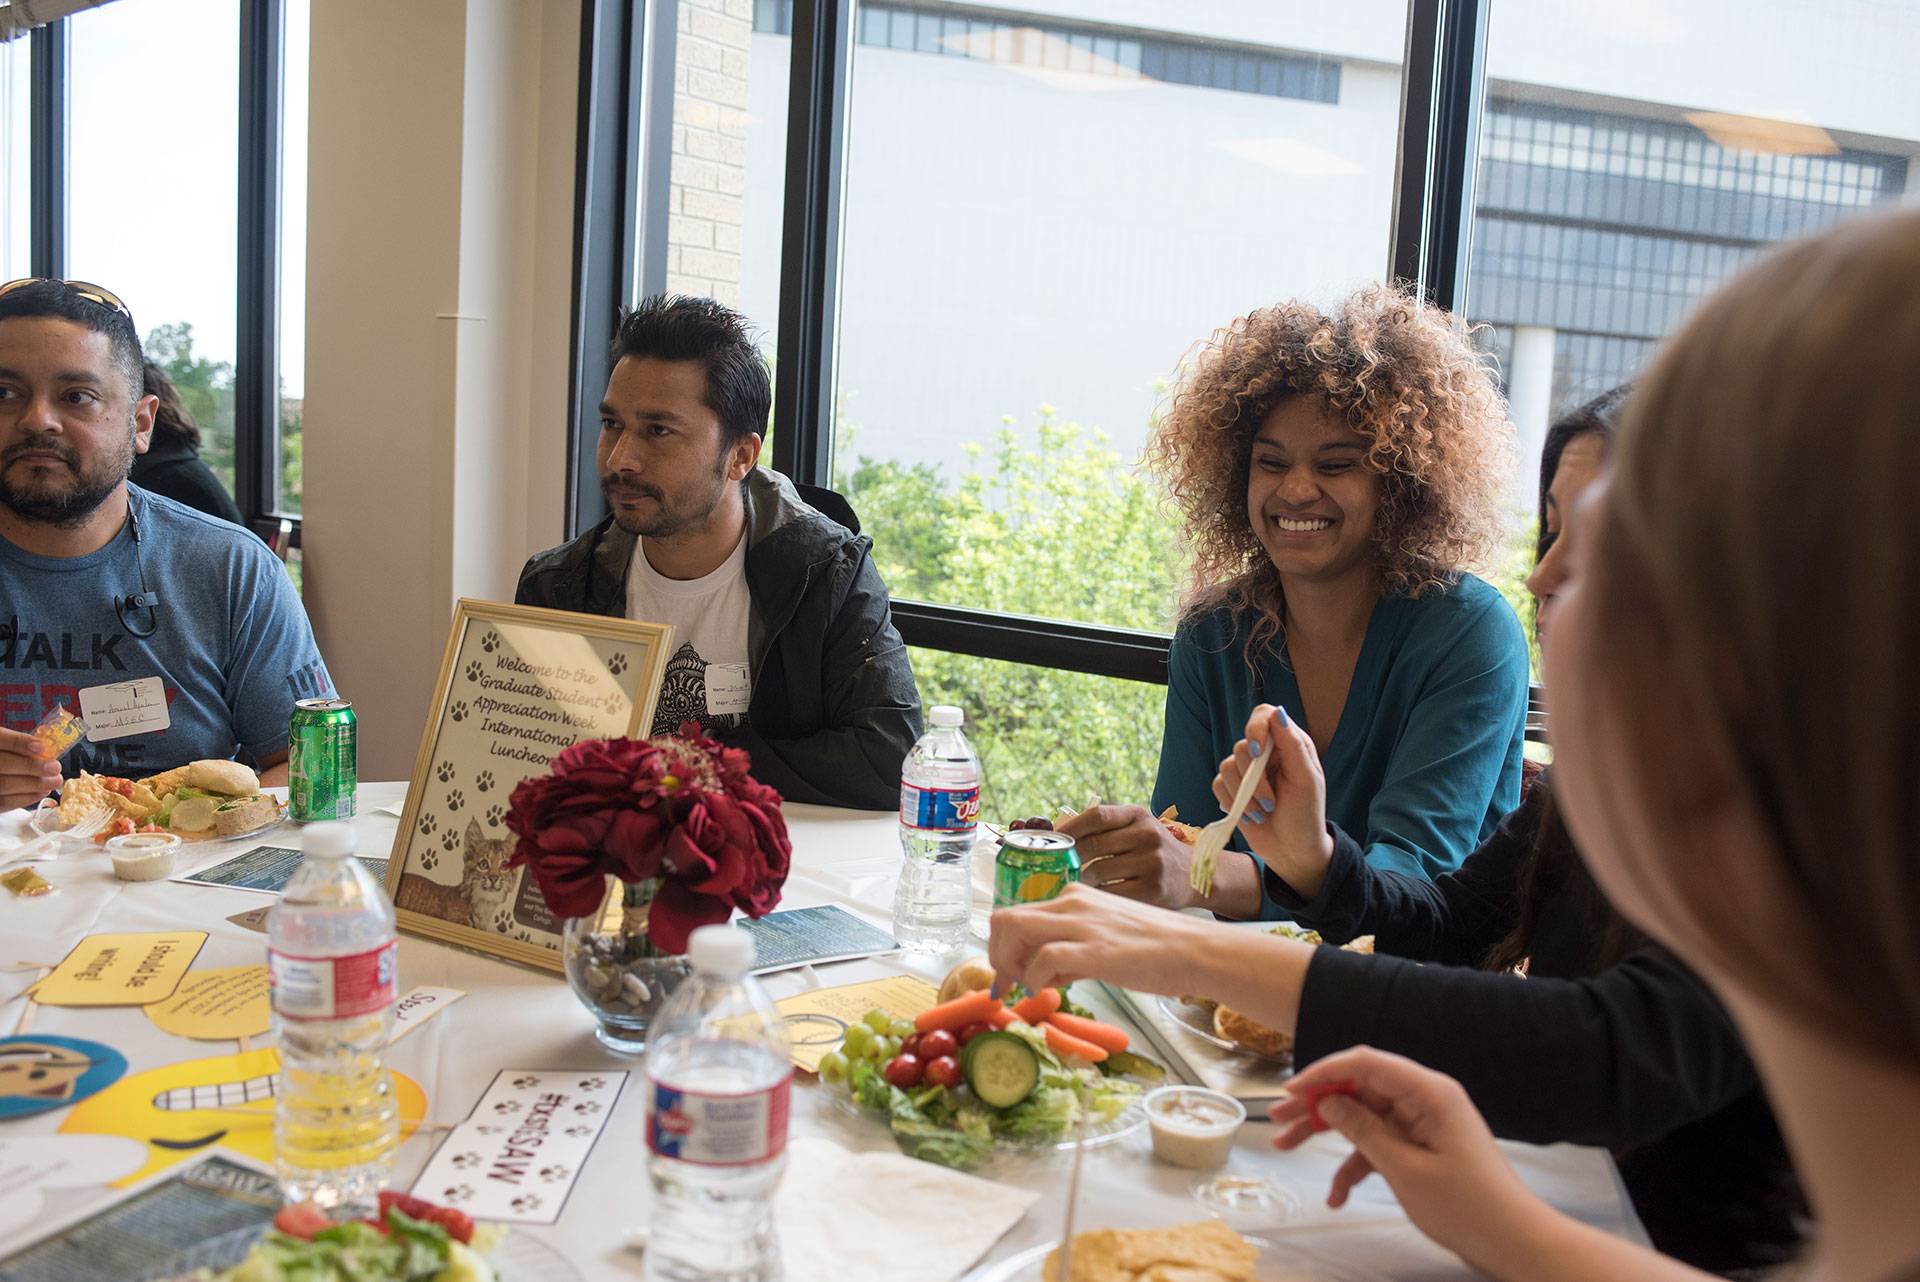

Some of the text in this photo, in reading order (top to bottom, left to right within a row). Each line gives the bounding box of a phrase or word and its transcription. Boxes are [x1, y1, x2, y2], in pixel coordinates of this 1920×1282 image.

[0, 632, 127, 671] TALK
[496, 655, 599, 685] Welcome to the
[480, 674, 607, 708] Graduate Student
[473, 695, 599, 729] Appreciation Week
[480, 718, 578, 747] International
[73, 947, 120, 981] writing!
[135, 945, 176, 974] should
[125, 974, 158, 988] be
